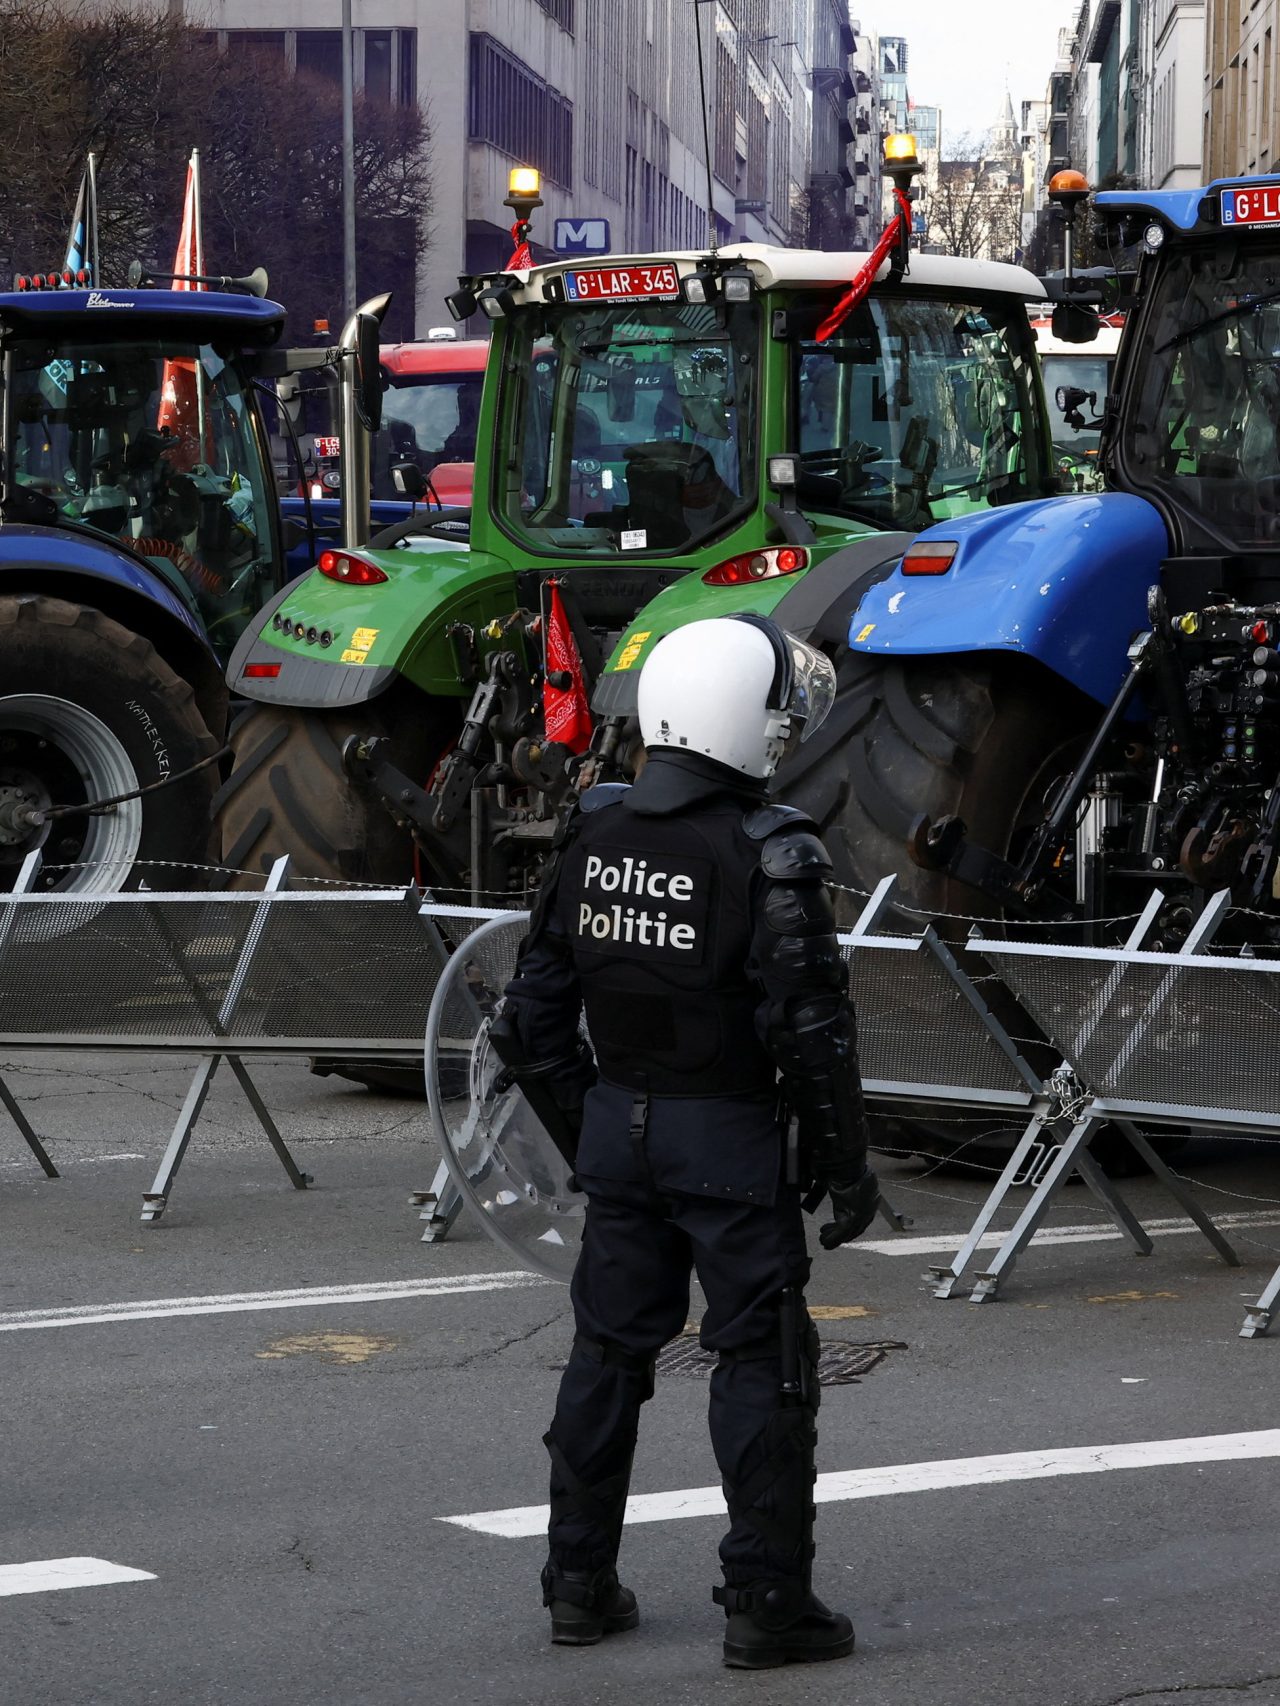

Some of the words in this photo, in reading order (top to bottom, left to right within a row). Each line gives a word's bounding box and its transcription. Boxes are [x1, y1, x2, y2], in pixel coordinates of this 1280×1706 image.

[577, 268, 675, 296] G-LAR-345
[584, 855, 694, 901] Police
[578, 903, 696, 950] Politie
